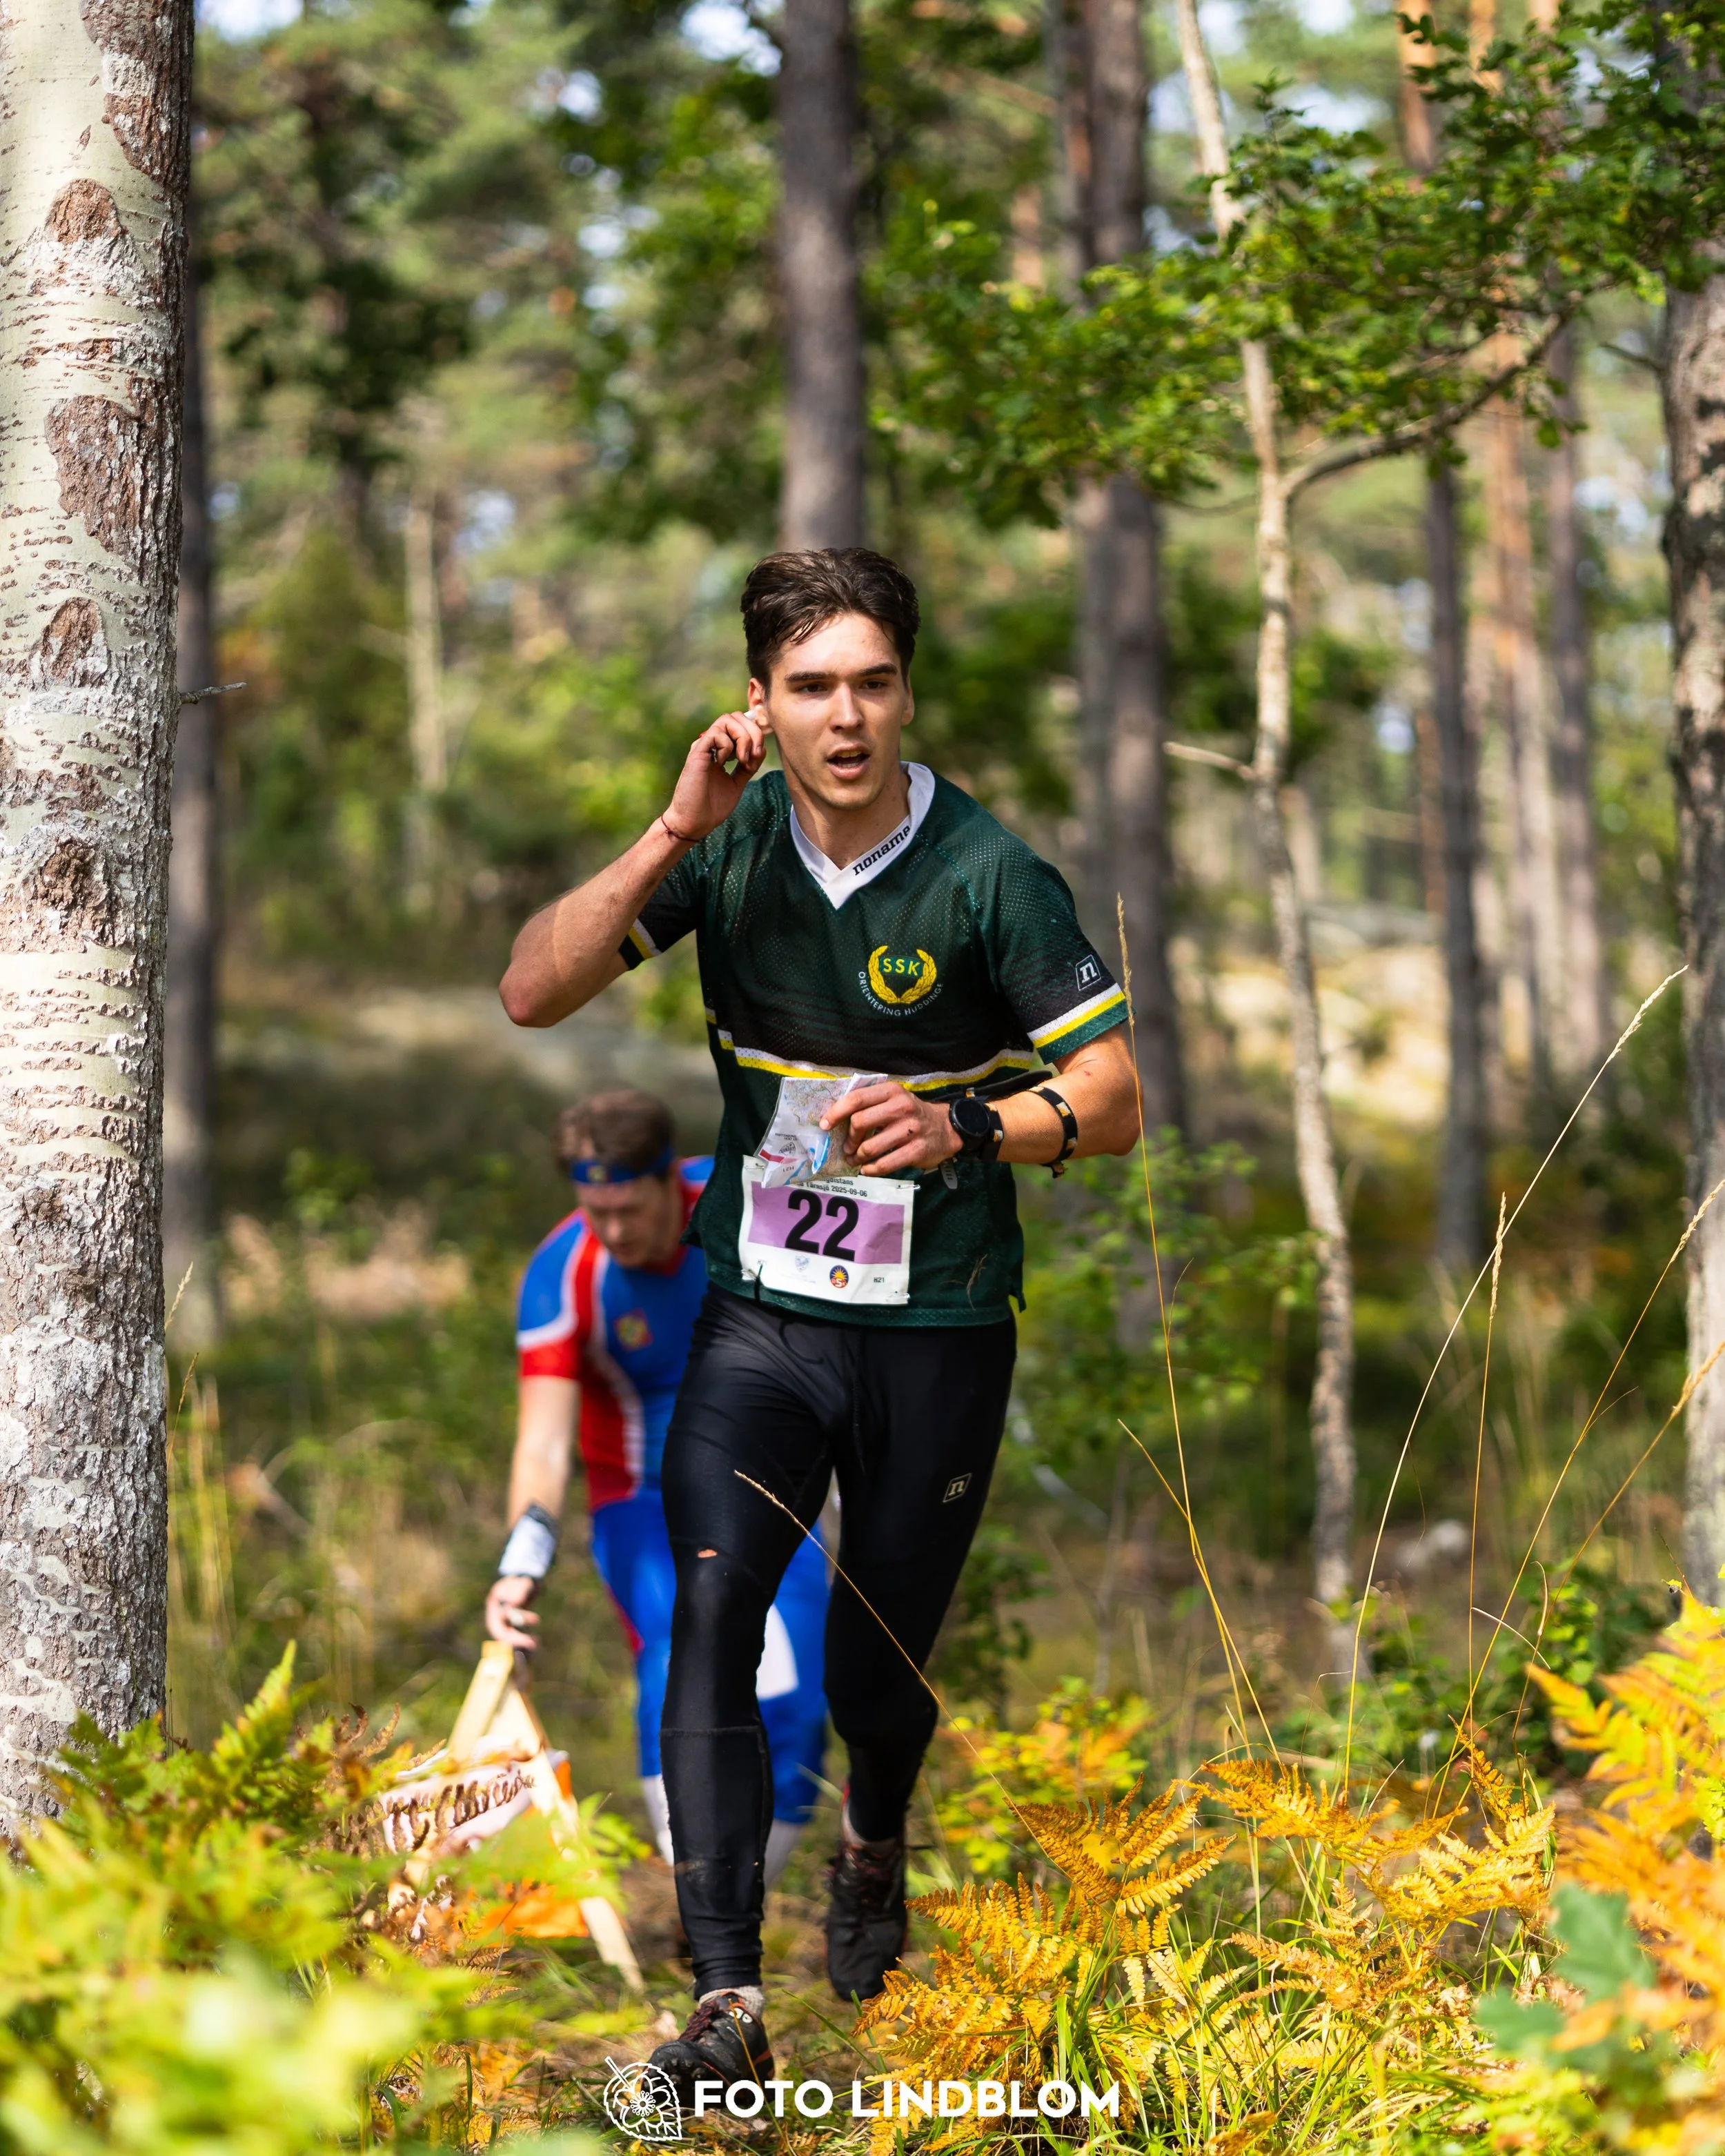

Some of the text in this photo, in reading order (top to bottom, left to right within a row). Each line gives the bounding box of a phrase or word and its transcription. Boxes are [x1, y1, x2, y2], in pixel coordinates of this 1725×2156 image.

[853, 825, 911, 876] noname
[883, 958, 920, 976] SSK
[858, 971, 944, 1016] ORIENTERING HUDDINGE
[831, 1185, 867, 1197] 2025-09-06
[784, 1189, 859, 1262] 22
